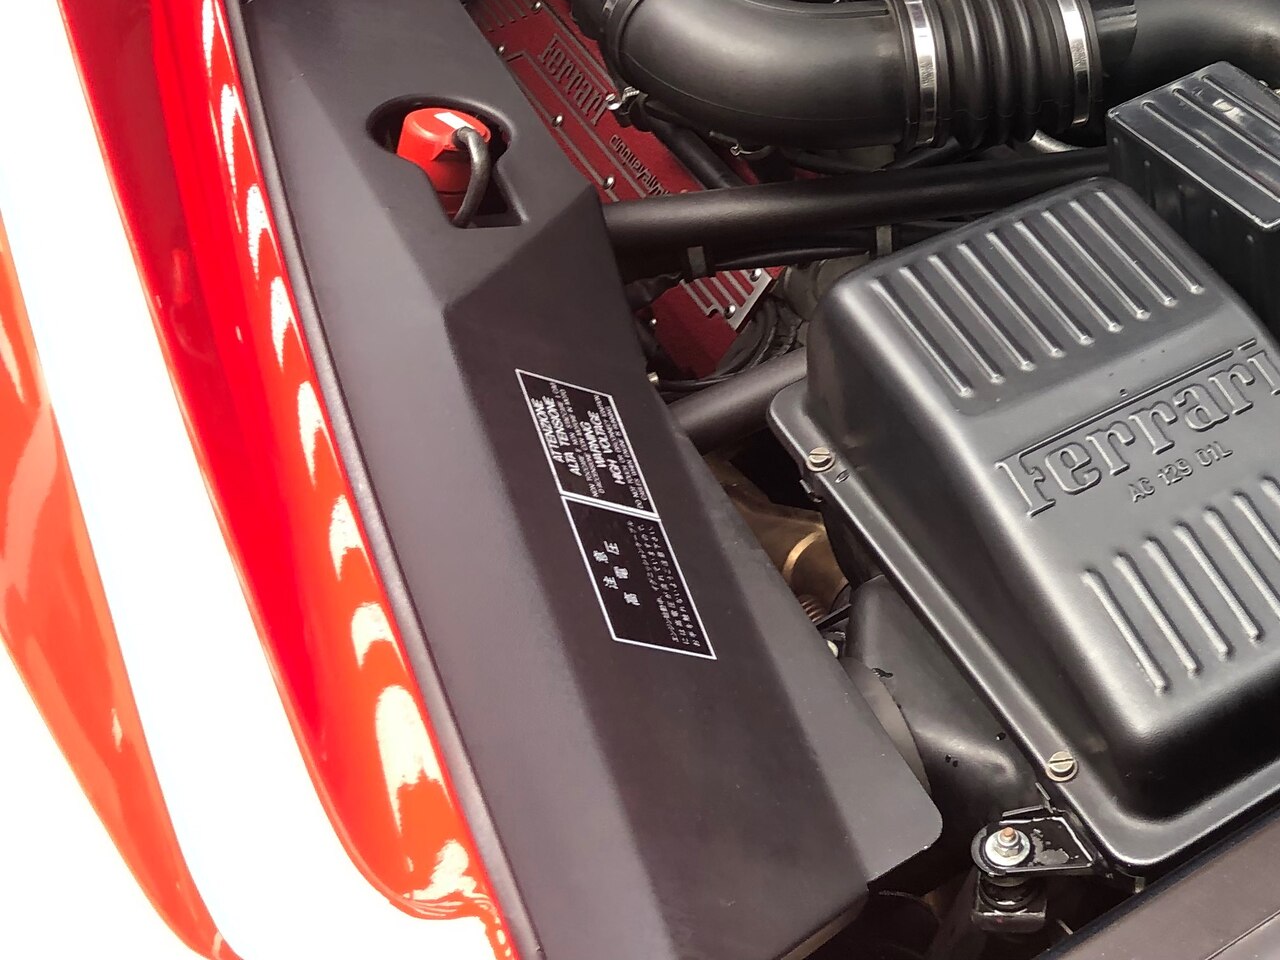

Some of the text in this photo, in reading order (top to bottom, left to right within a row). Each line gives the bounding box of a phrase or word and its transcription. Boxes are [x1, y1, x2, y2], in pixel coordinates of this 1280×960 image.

[538, 34, 608, 126] Ferrari
[531, 398, 565, 463] ATTENZIONE
[542, 396, 582, 476] ALTA TENSIONE
[579, 421, 607, 467] WARNING
[587, 410, 626, 485] HIGH VOLTAGE
[1128, 477, 1155, 502] AC
[1158, 458, 1193, 487] 129
